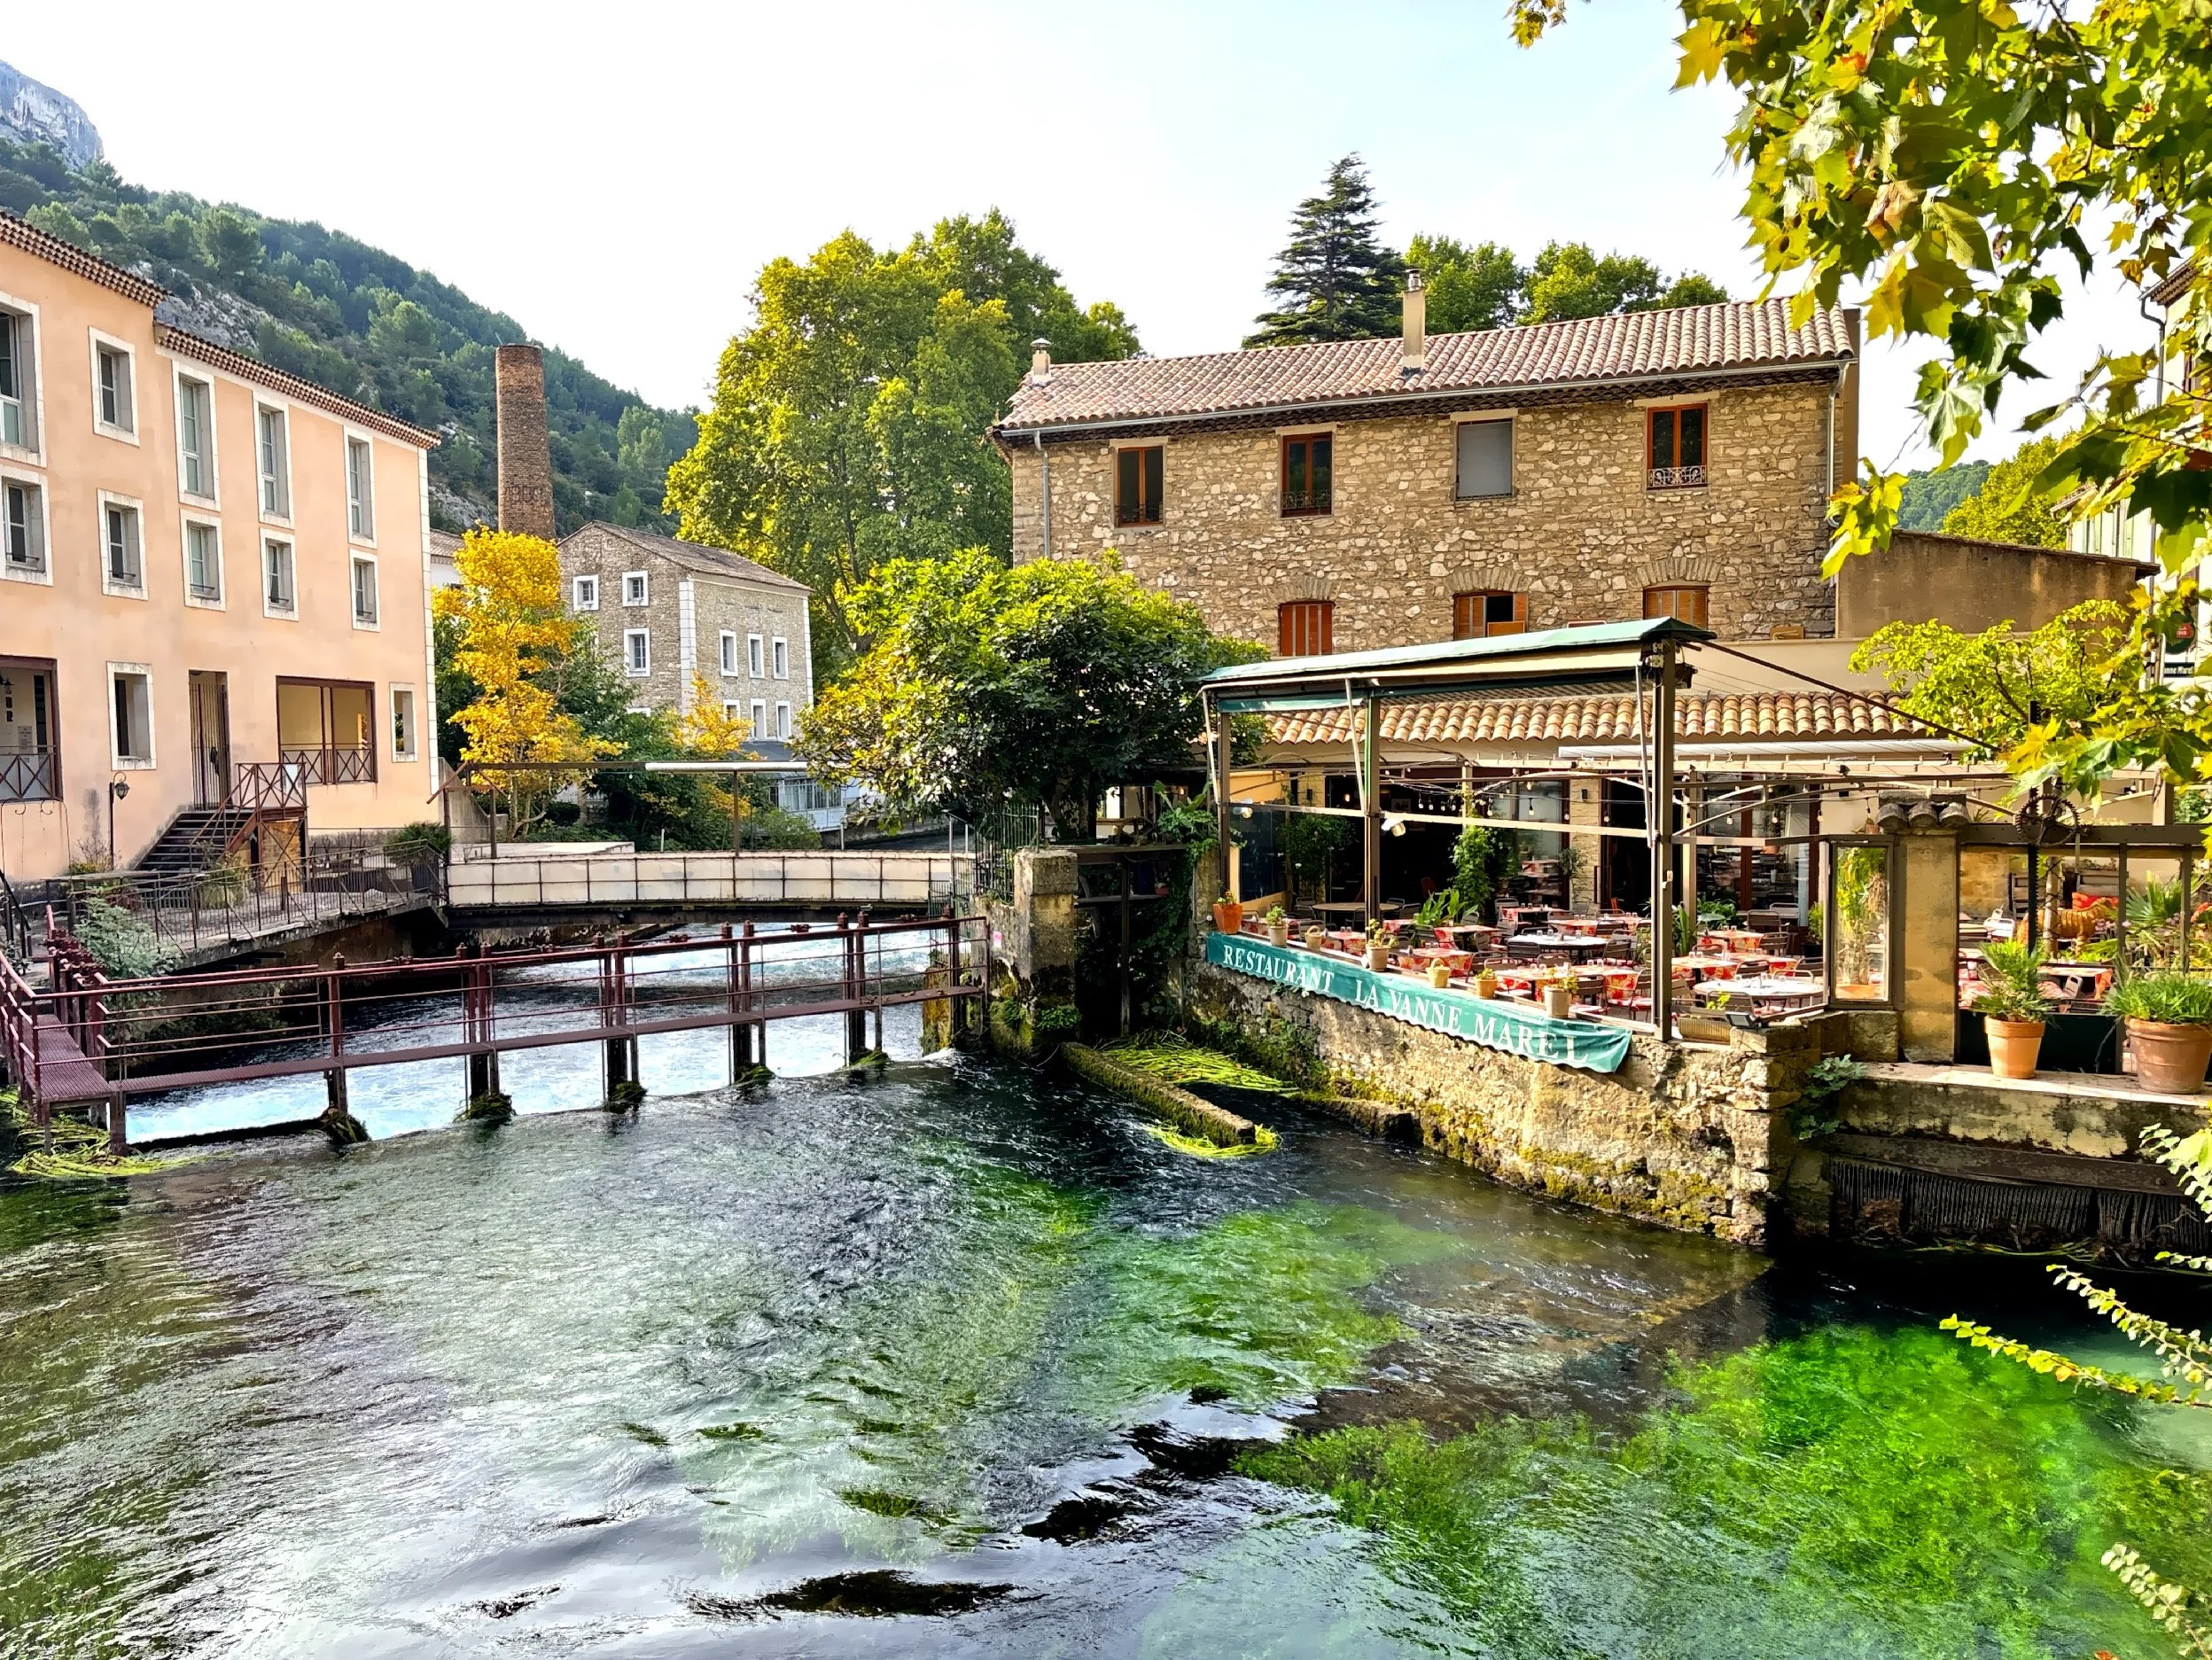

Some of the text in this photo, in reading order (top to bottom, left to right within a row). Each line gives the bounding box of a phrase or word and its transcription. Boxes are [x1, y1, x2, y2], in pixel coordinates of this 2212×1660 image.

[1223, 945, 1589, 1064] RESTAURANT LA VANNE MAREL
